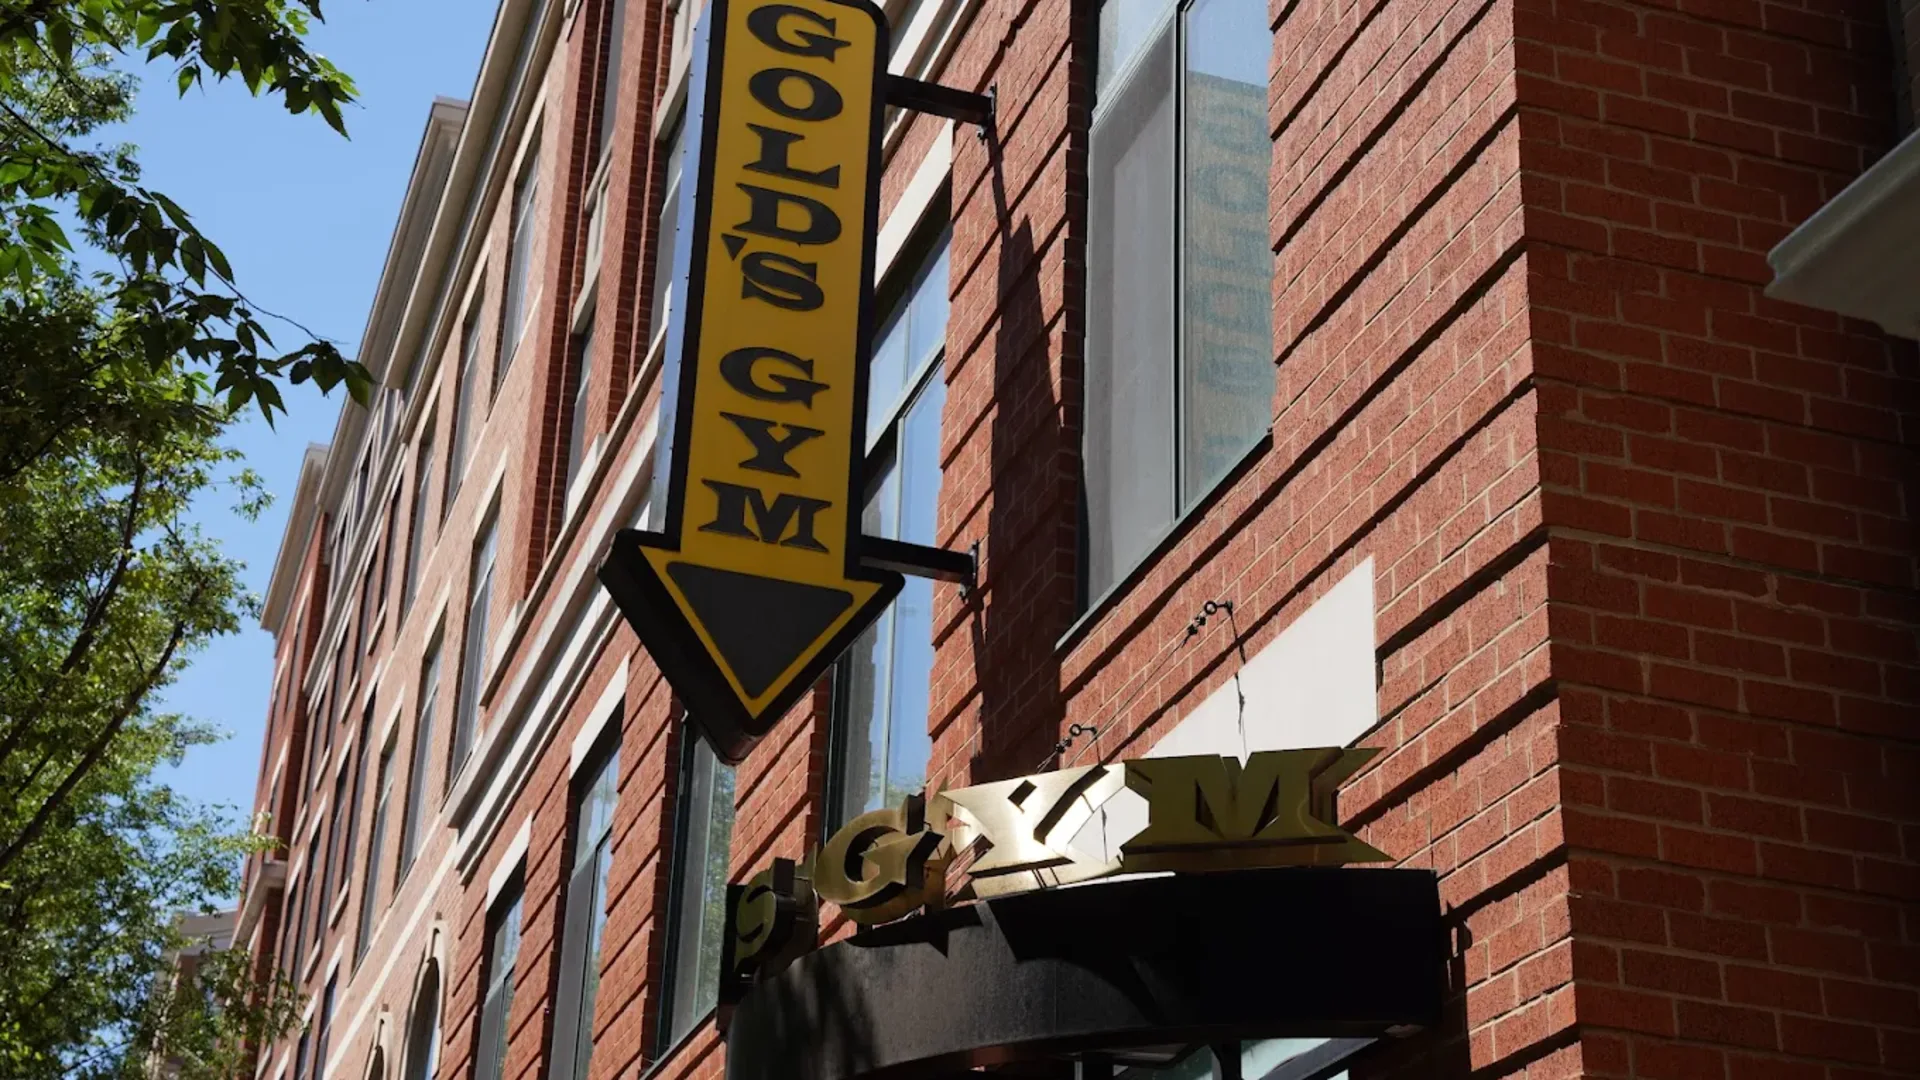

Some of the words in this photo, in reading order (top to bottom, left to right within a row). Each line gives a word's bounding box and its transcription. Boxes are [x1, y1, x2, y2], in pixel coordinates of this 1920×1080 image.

[721, 4, 852, 312] GOLD'S
[697, 346, 833, 554] GYM
[814, 747, 1396, 914] GYM
